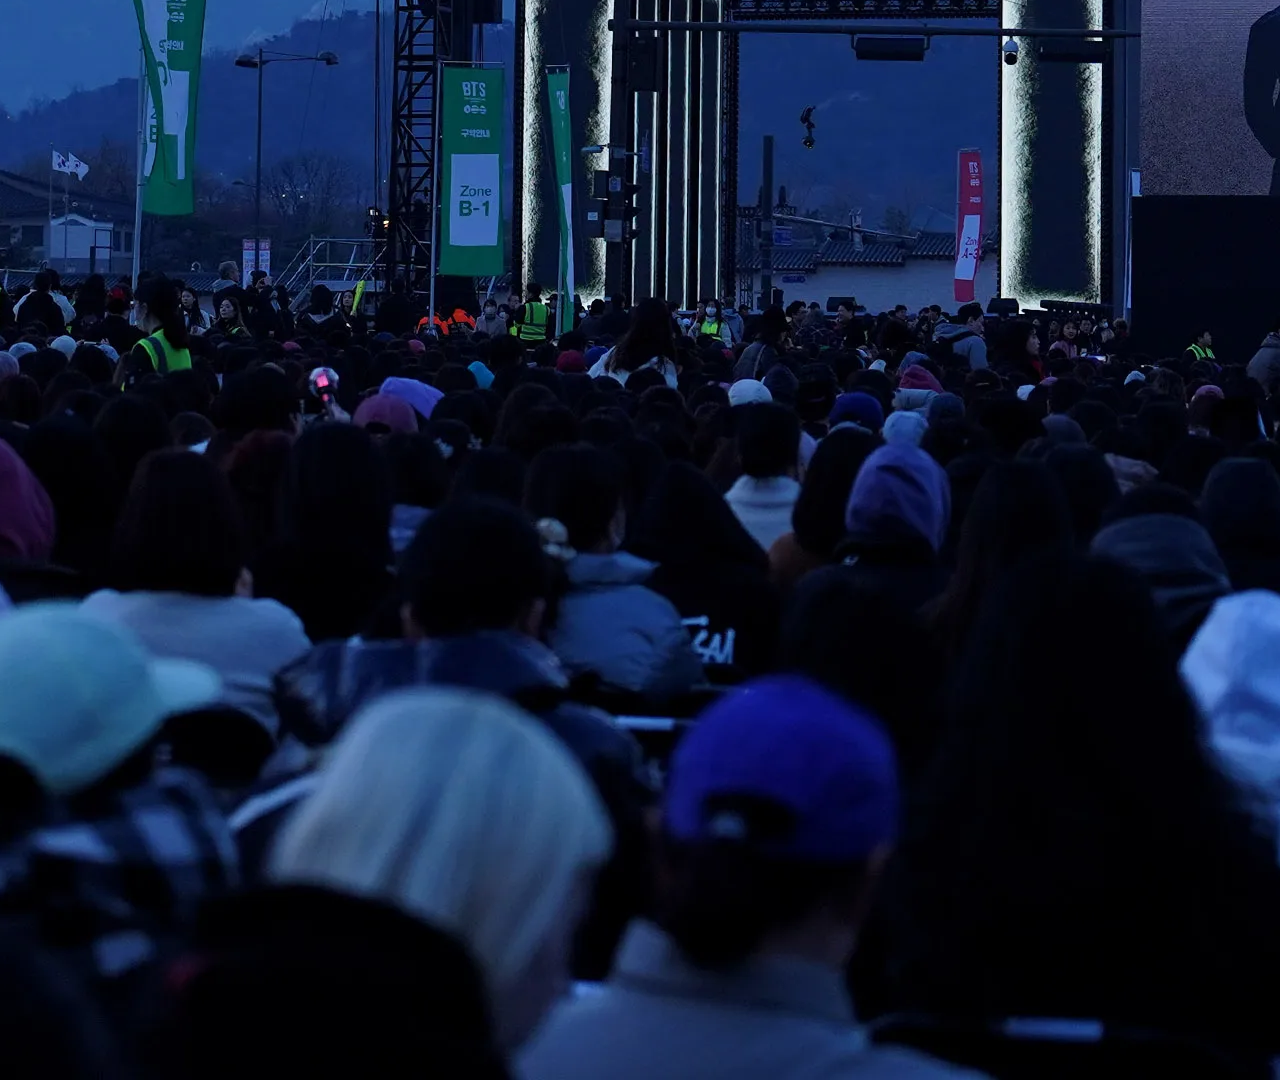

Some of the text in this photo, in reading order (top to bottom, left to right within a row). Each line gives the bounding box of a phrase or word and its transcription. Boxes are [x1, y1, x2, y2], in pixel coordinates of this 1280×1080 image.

[462, 81, 486, 97] BTS
[460, 185, 492, 197] Zone
[459, 200, 489, 217] B-1
[965, 236, 978, 245] Zon
